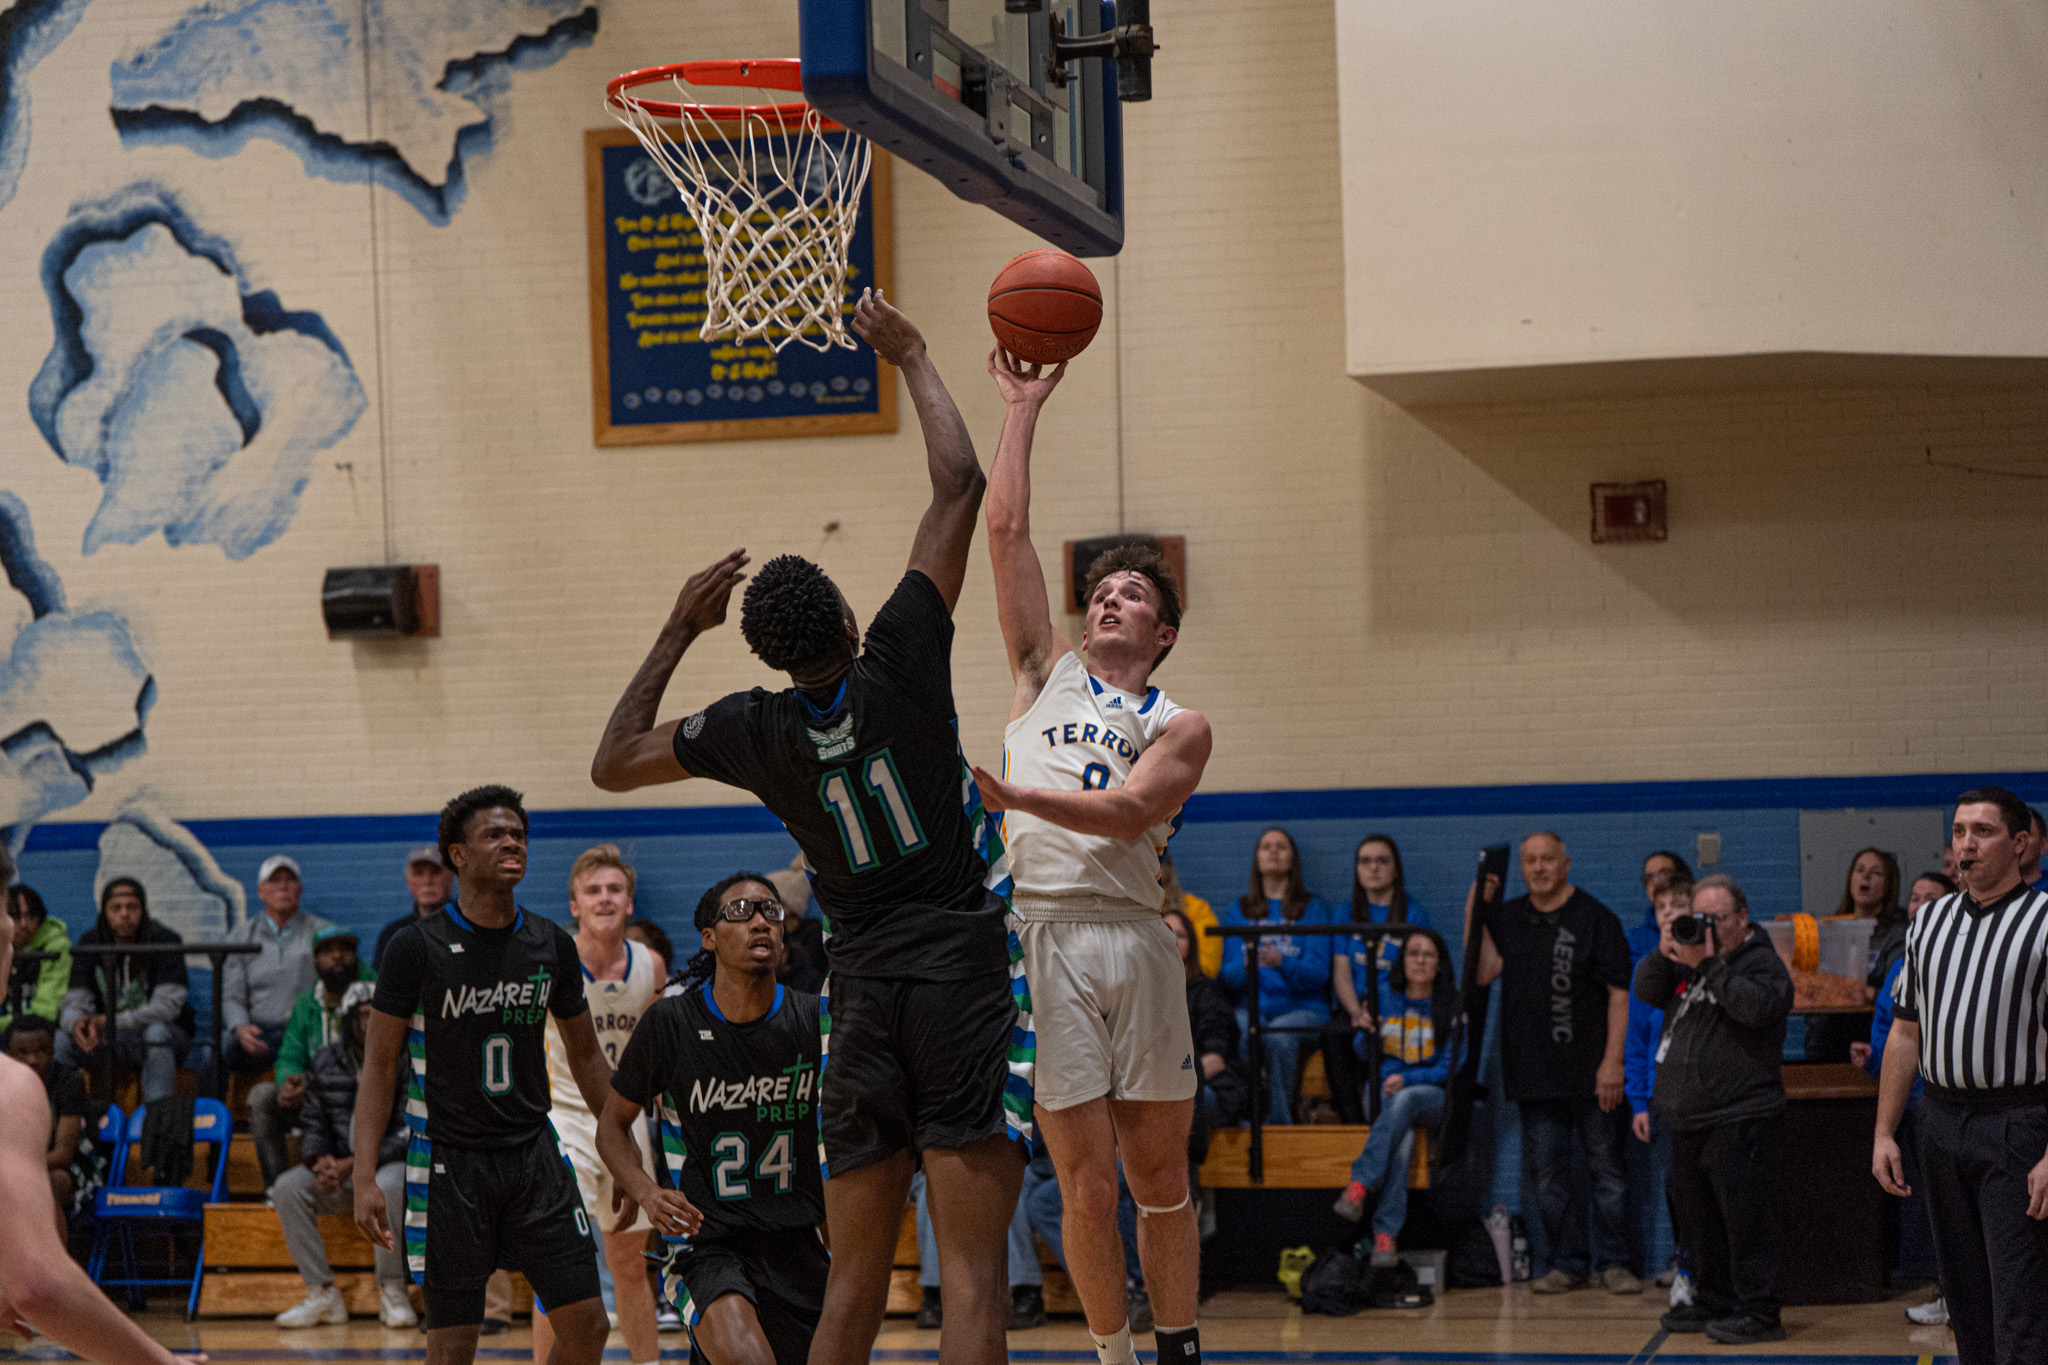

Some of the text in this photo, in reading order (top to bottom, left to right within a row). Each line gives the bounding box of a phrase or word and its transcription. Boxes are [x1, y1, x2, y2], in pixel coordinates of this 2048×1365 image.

[818, 747, 929, 874] 11
[441, 964, 551, 1019] NAZARETH
[502, 1008, 545, 1025] PREP
[482, 1033, 514, 1097] 0
[689, 1053, 814, 1114] NAZARETH
[756, 1102, 810, 1123] PREP
[711, 1128, 797, 1201] 24
